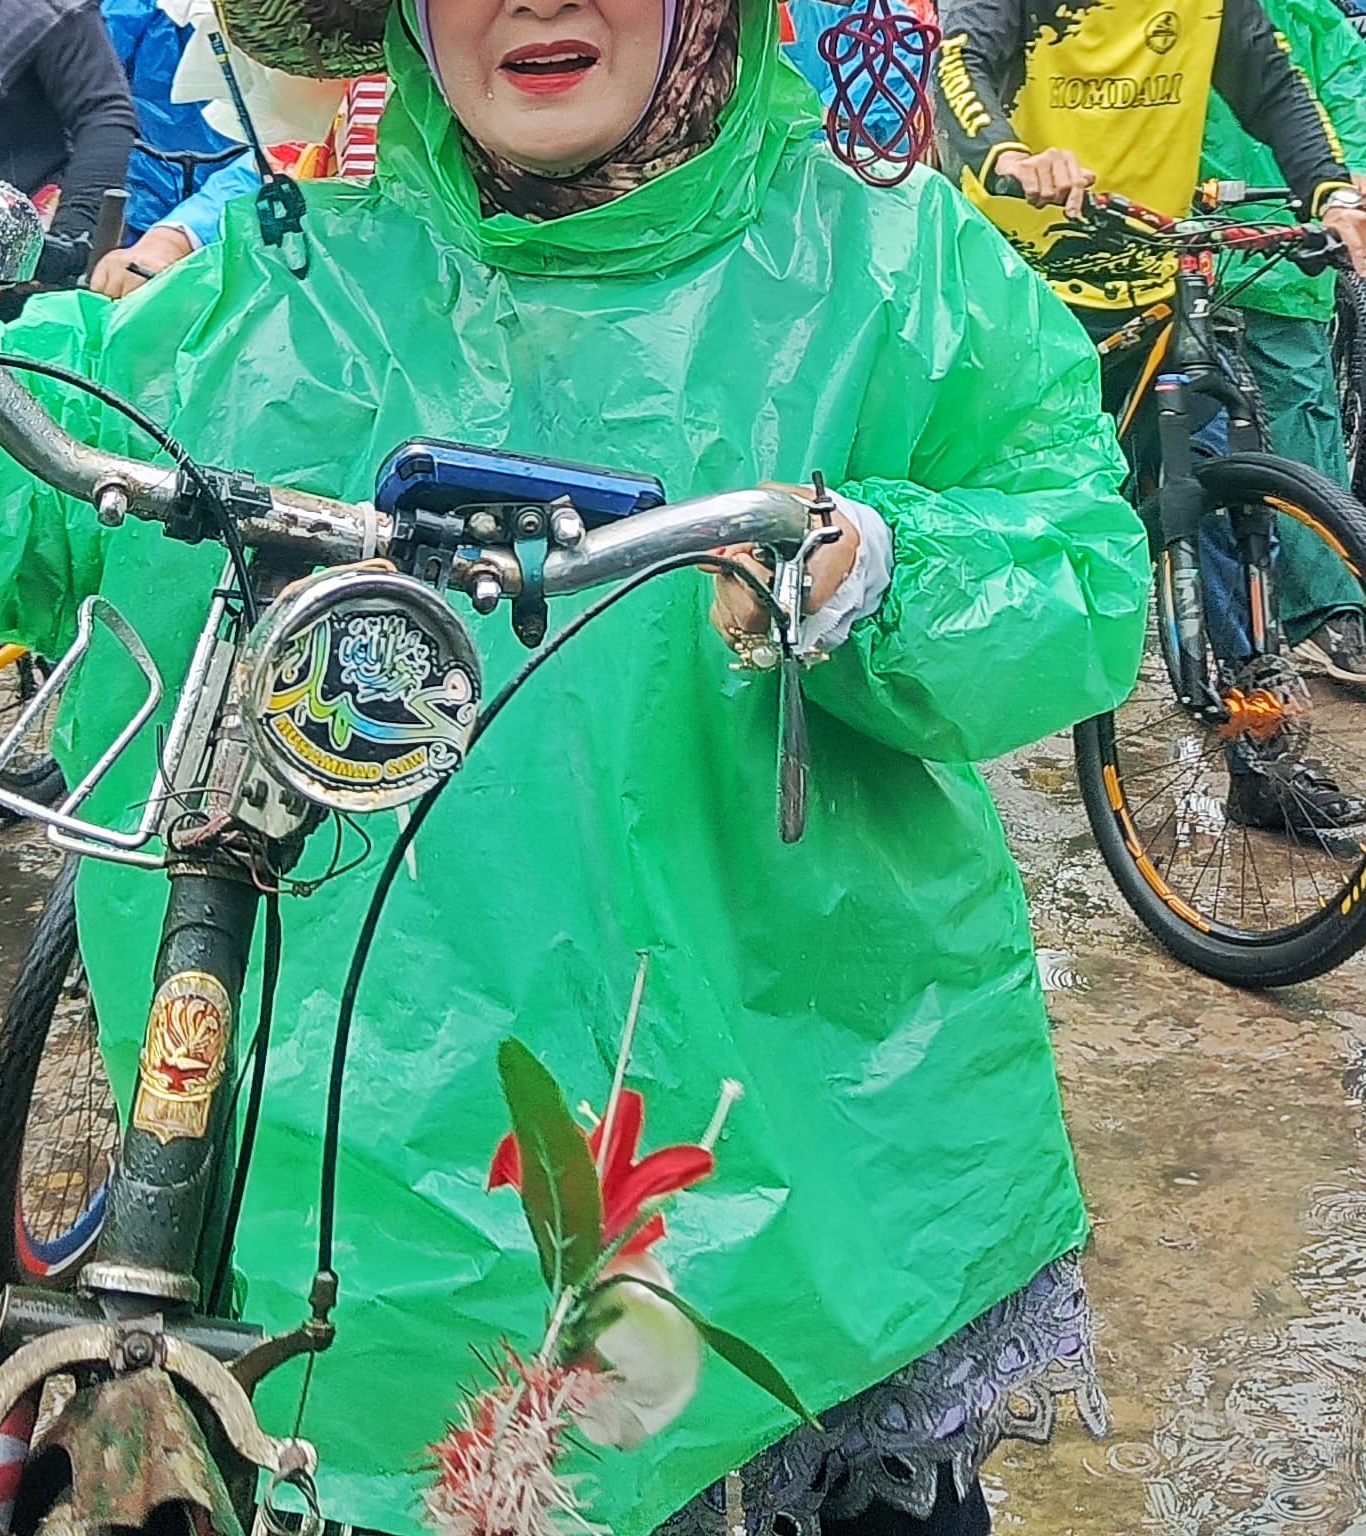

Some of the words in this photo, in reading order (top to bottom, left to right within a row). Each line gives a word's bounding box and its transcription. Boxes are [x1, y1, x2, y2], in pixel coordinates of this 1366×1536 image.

[1048, 72, 1184, 110] KOMDALI
[274, 717, 382, 780] MUHAMMAD
[386, 746, 427, 777] SAW
